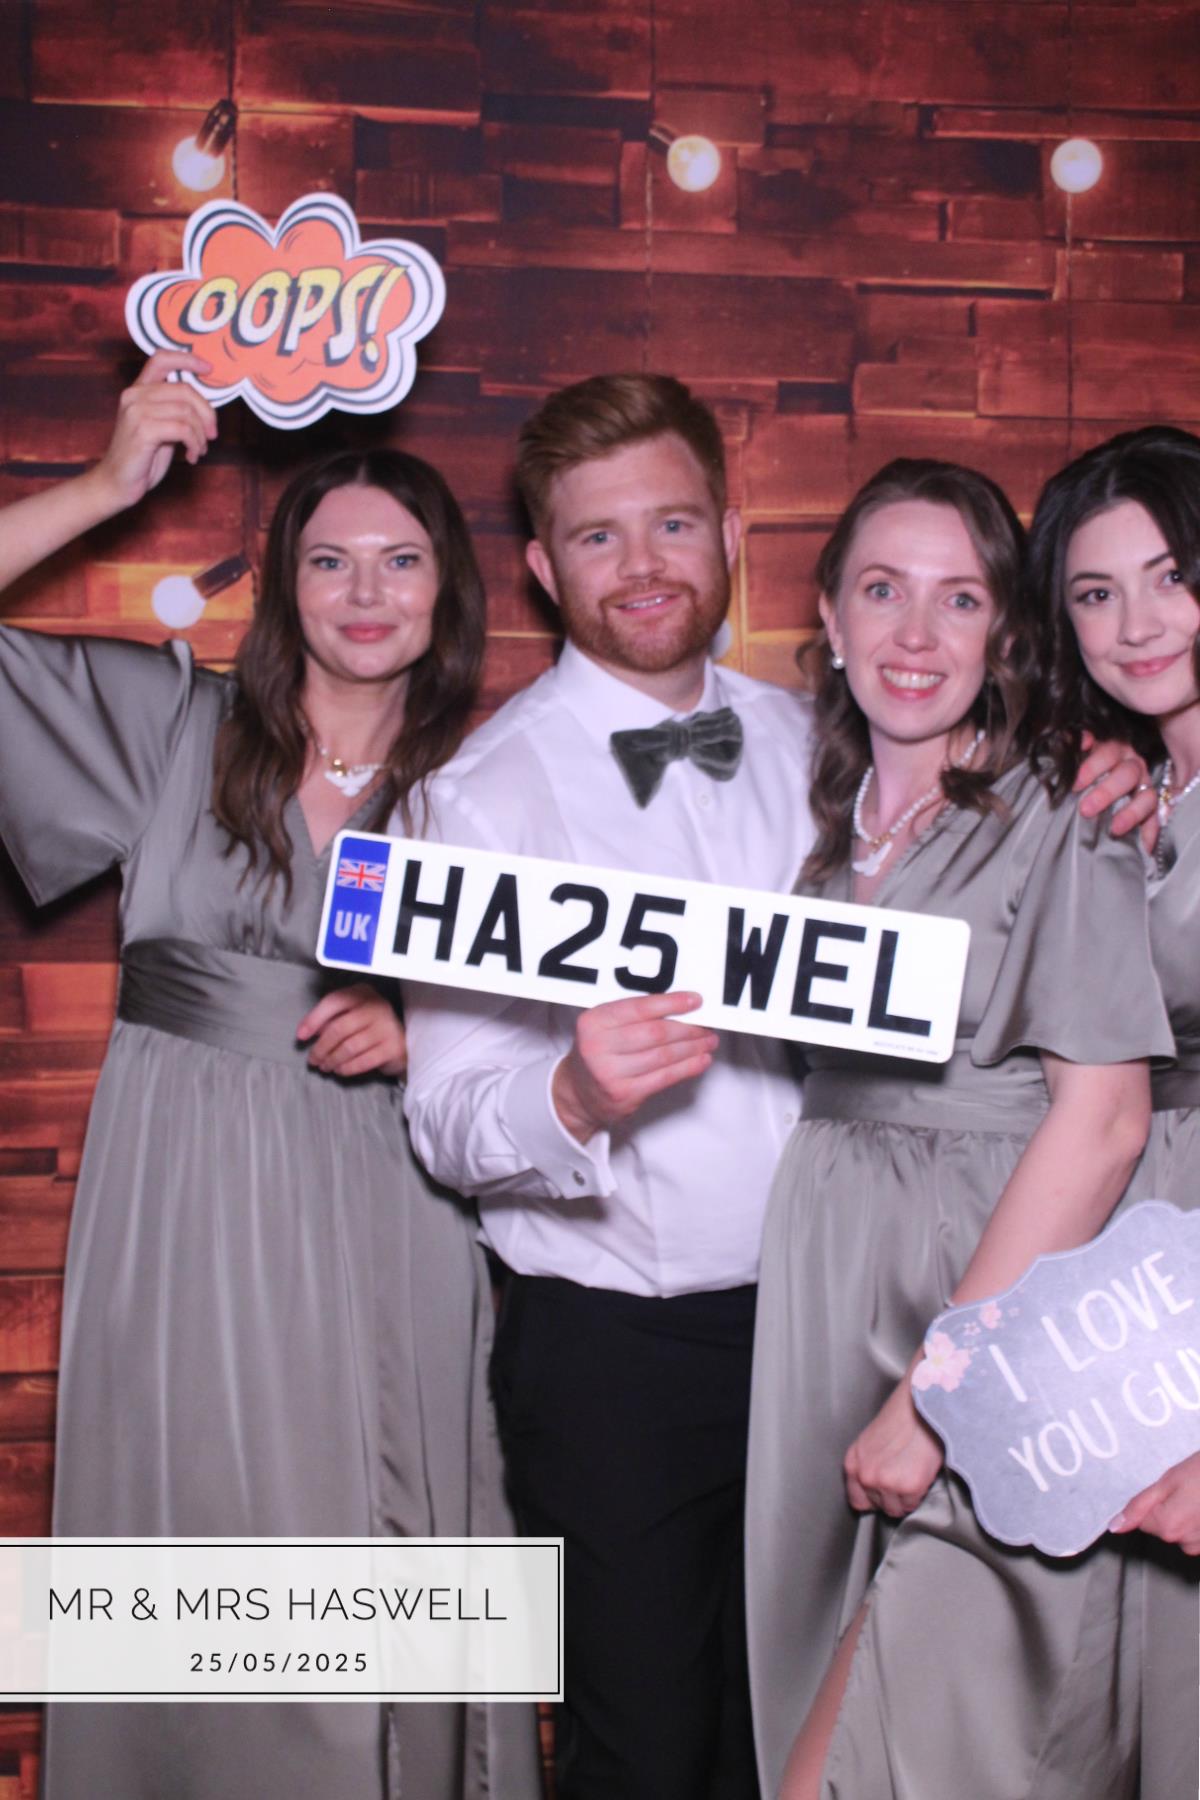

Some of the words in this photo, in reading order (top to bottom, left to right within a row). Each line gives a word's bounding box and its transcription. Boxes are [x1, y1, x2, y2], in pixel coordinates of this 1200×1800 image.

[179, 264, 410, 373] OOPS!
[333, 910, 372, 942] UK
[392, 859, 687, 994] HA25
[722, 906, 932, 1037] WEL
[989, 1344, 1028, 1403] I
[1040, 1251, 1195, 1372] LOVE
[1008, 1397, 1121, 1493] YOU
